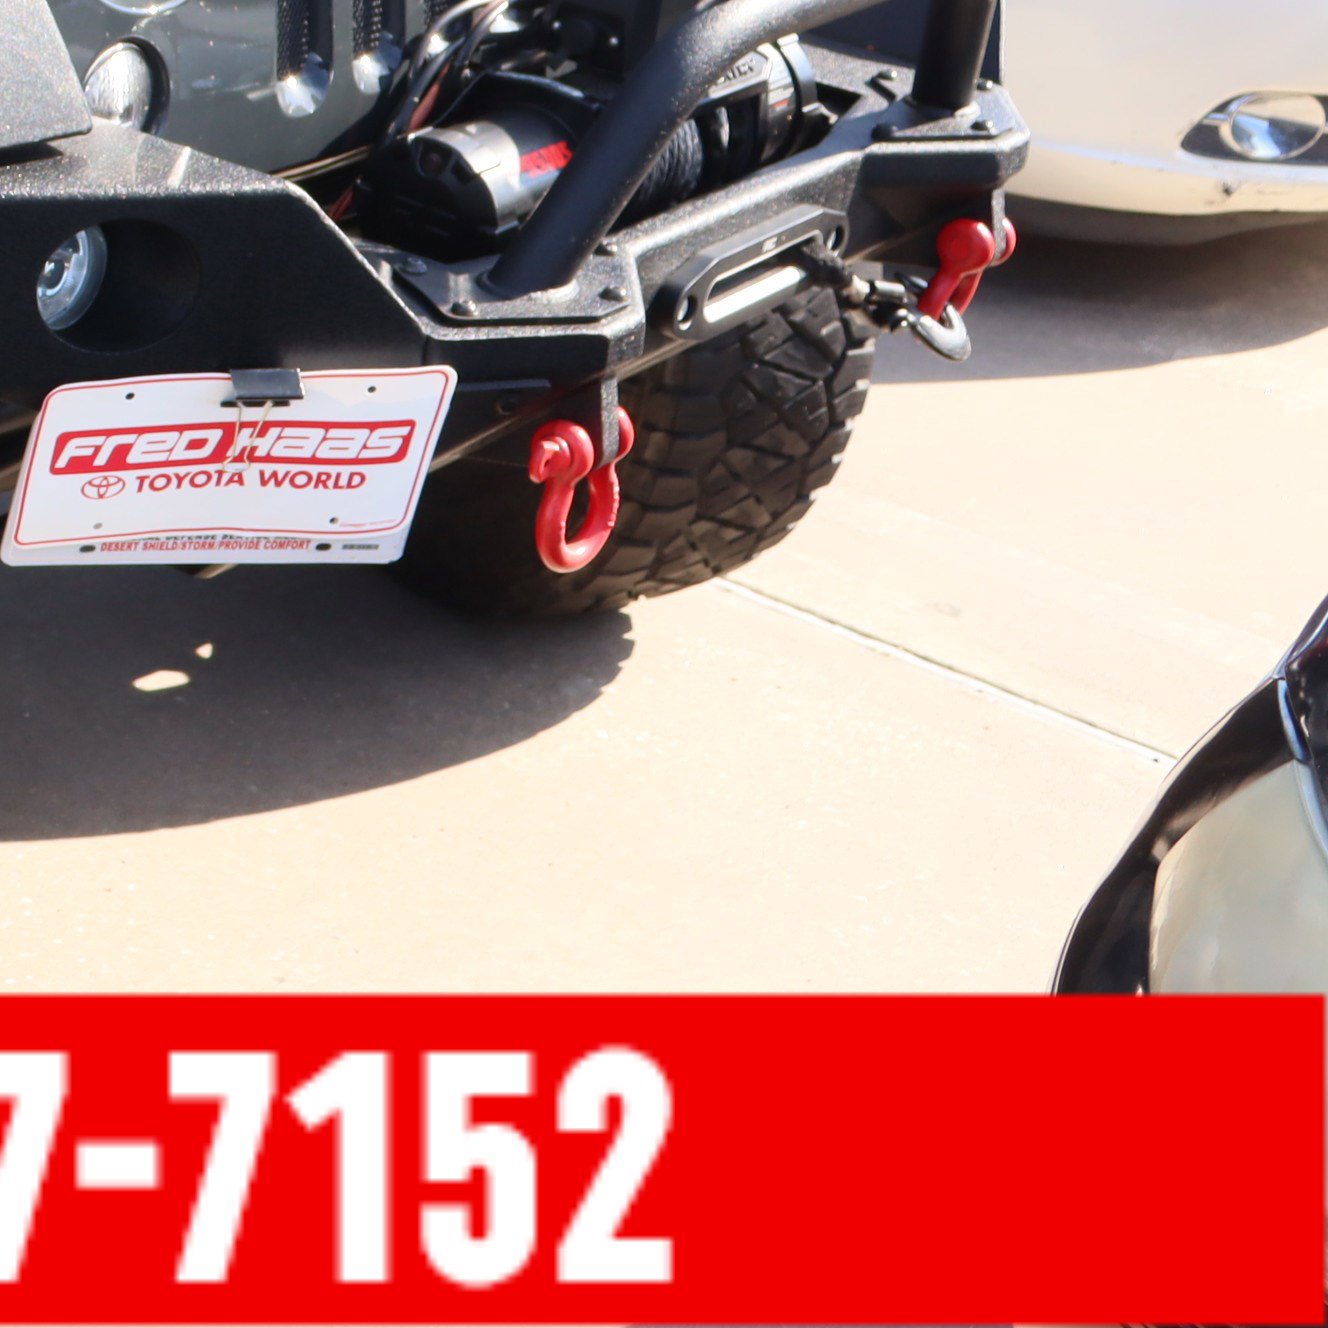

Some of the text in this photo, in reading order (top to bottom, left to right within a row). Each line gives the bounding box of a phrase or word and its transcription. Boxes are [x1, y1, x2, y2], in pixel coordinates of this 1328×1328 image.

[135, 469, 367, 493] TOYOTA WORLD
[100, 541, 139, 552] DESERT
[263, 539, 312, 551] COMFORT
